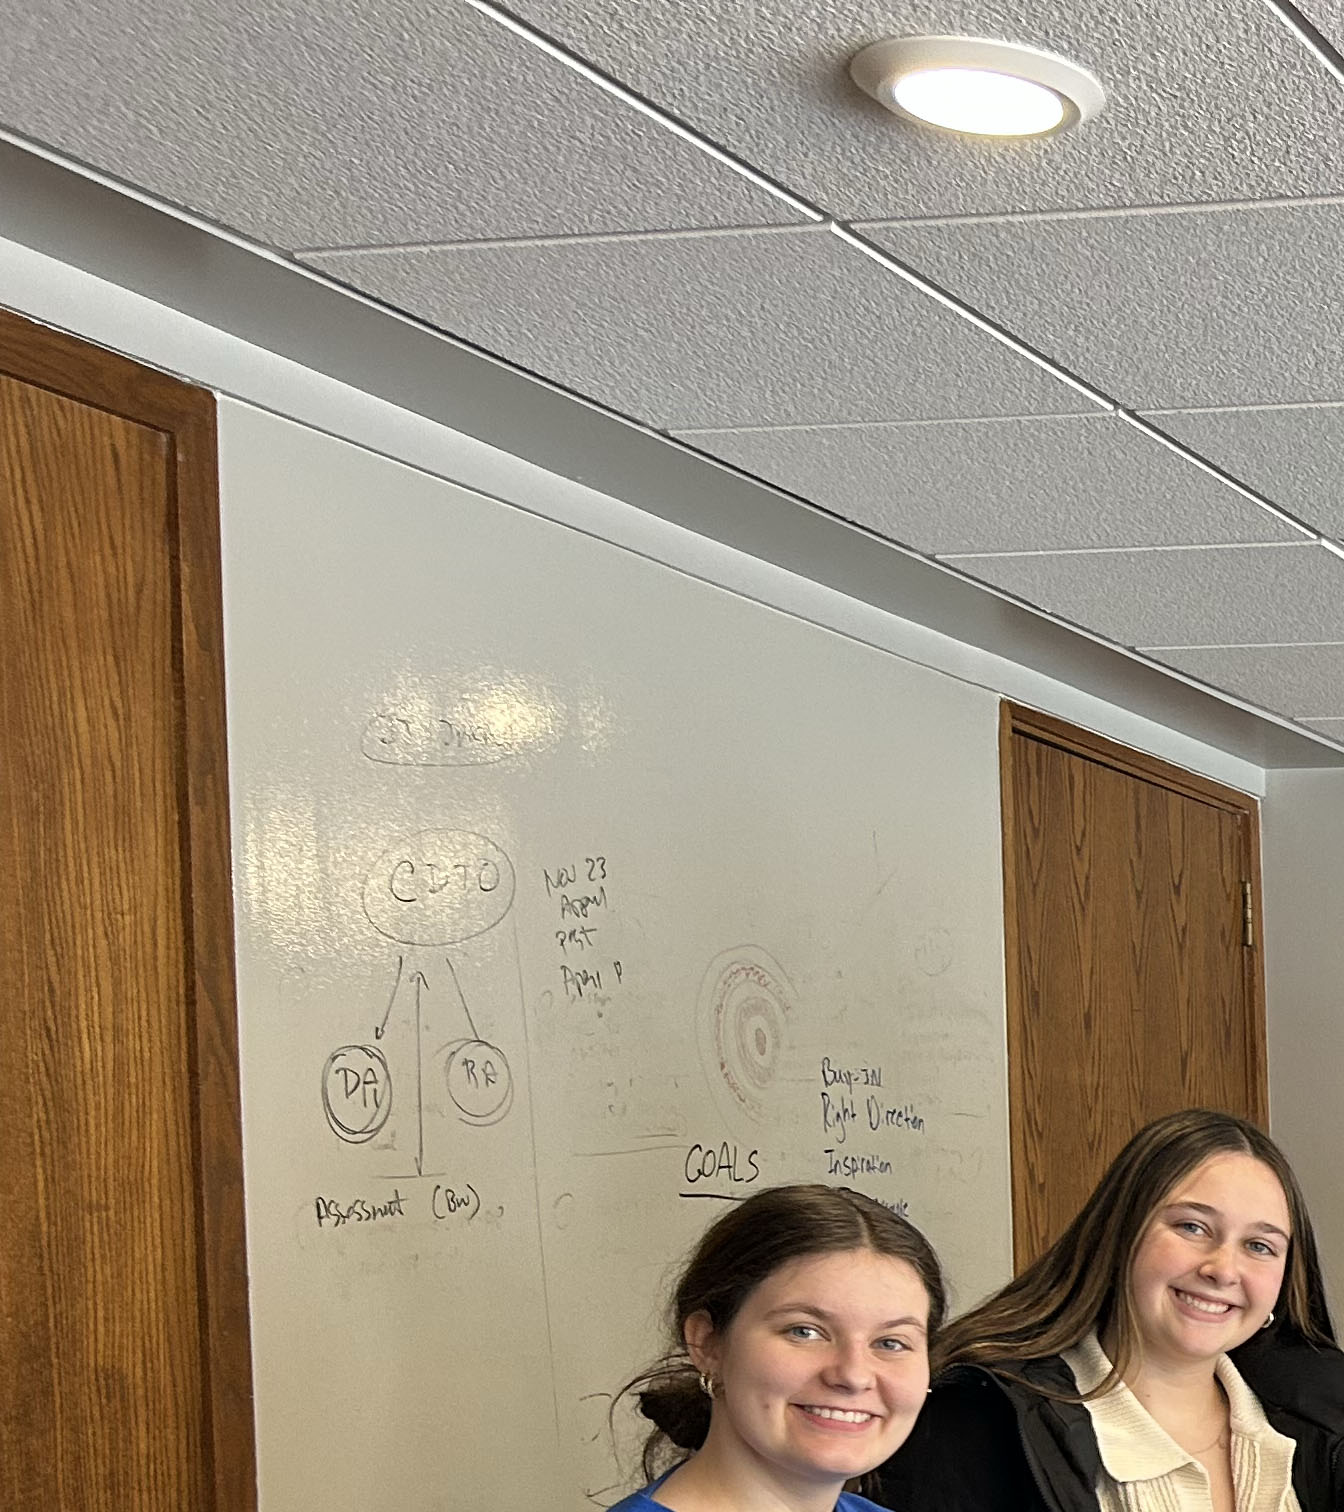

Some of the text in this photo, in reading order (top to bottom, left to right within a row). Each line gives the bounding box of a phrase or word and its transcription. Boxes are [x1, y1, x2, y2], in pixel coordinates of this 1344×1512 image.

[585, 856, 607, 882] 23
[820, 1091, 926, 1144] Right Direction
[684, 1141, 761, 1183] GOALS
[823, 1148, 894, 1180] Inspiration
